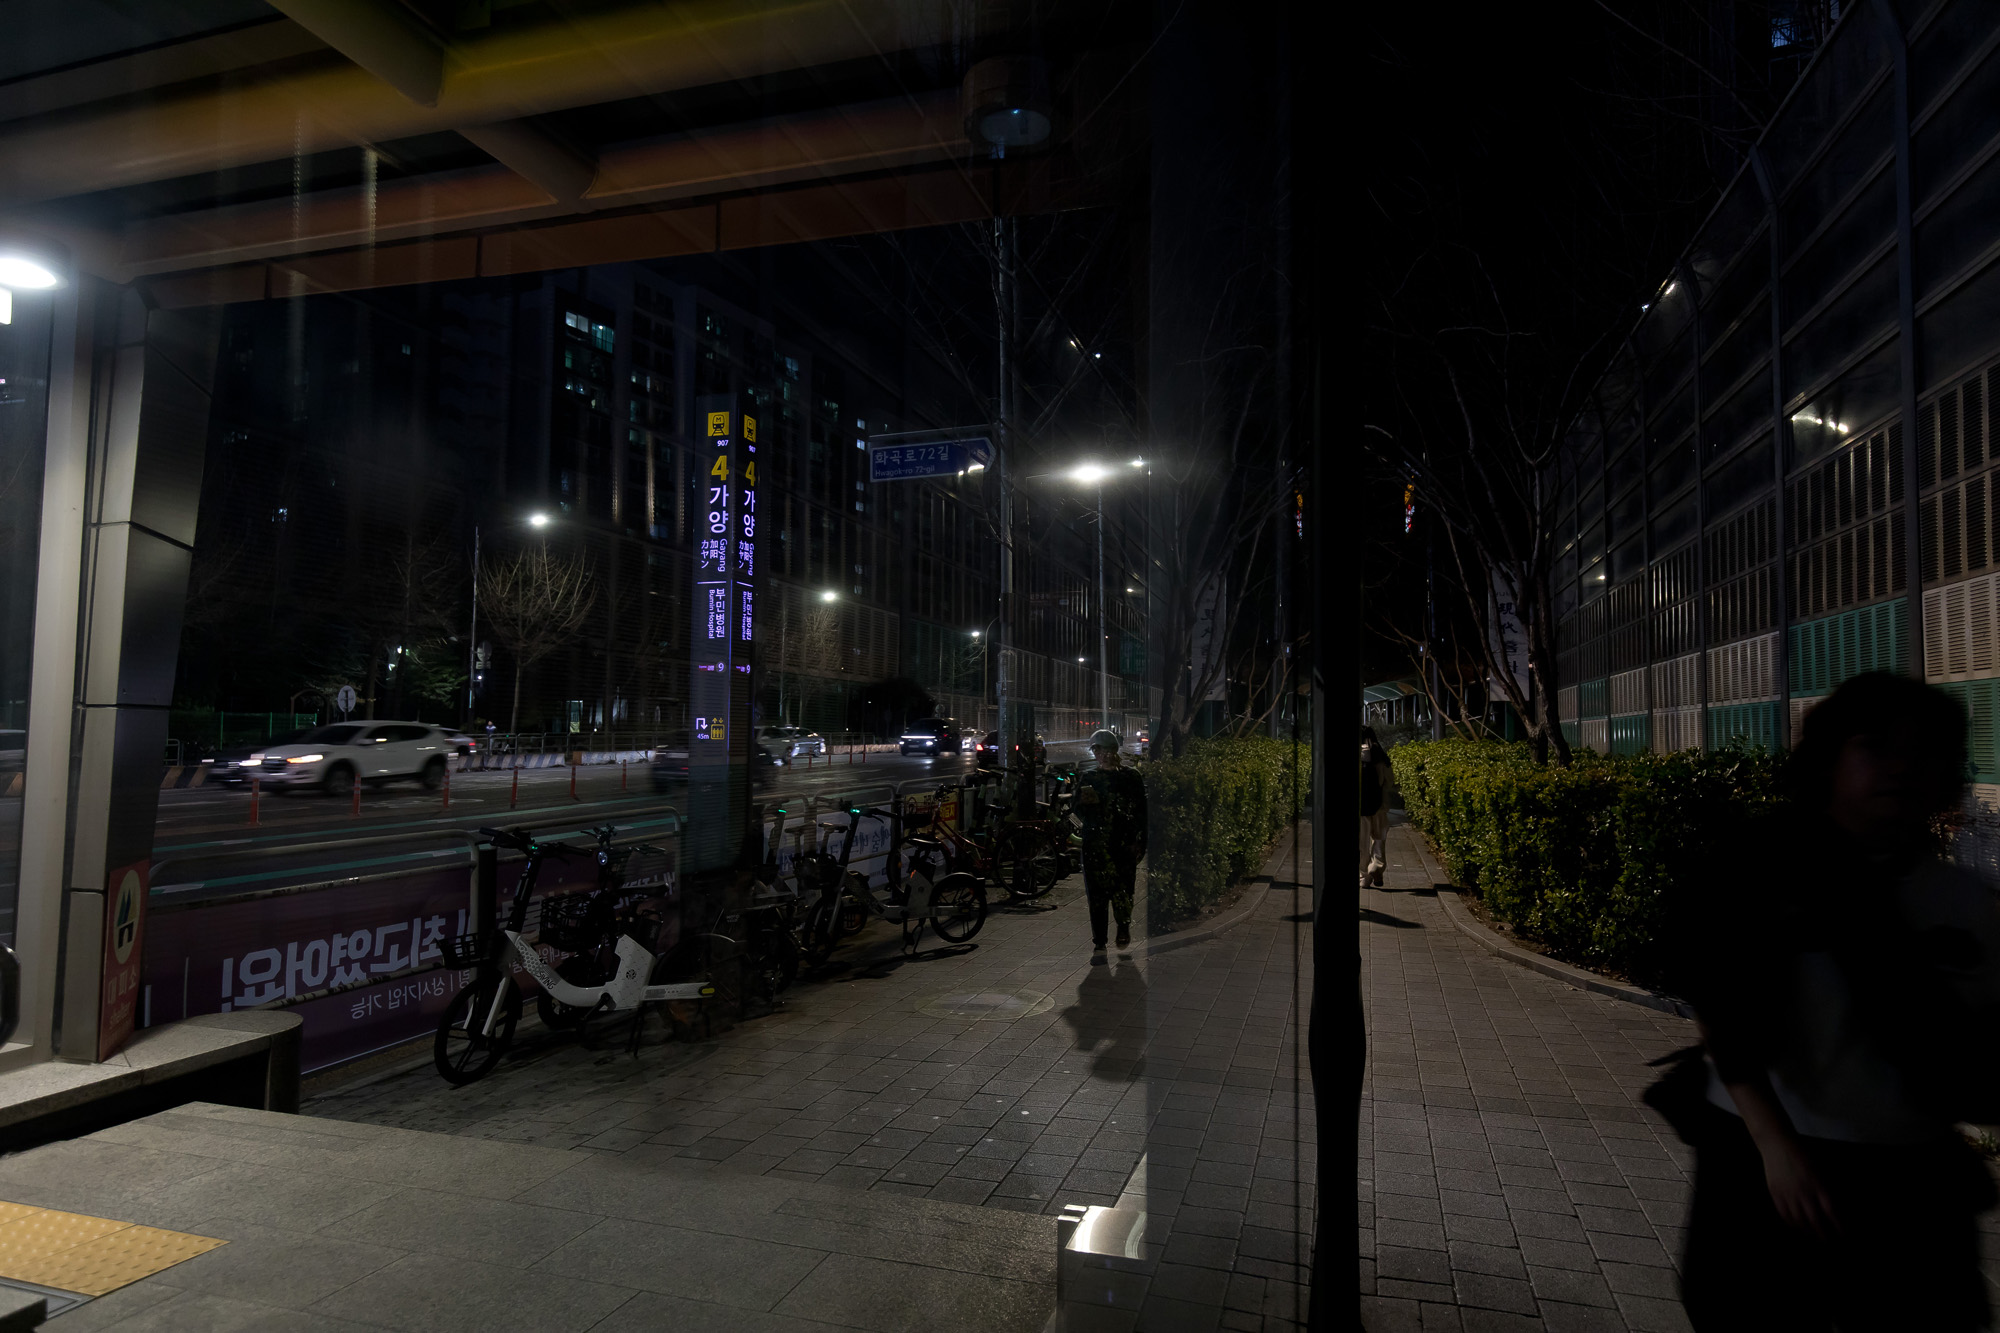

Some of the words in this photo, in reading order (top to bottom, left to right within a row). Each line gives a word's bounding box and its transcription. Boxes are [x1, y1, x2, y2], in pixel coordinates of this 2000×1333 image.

[716, 439, 730, 447] 907
[875, 445, 949, 465] 화곡로72길
[711, 455, 729, 481] 4
[745, 461, 756, 487] 4
[875, 468, 913, 477] Hwagok-ro
[915, 464, 935, 475] 72-gil
[708, 483, 730, 535] 가양
[743, 489, 756, 539] 가양
[717, 538, 728, 573] Gayang
[747, 543, 755, 577] Gayang
[708, 589, 716, 611] Bumin
[707, 612, 716, 640] Hospital
[714, 588, 726, 639] 부민병원
[718, 663, 724, 672] 9
[745, 664, 751, 674] 9
